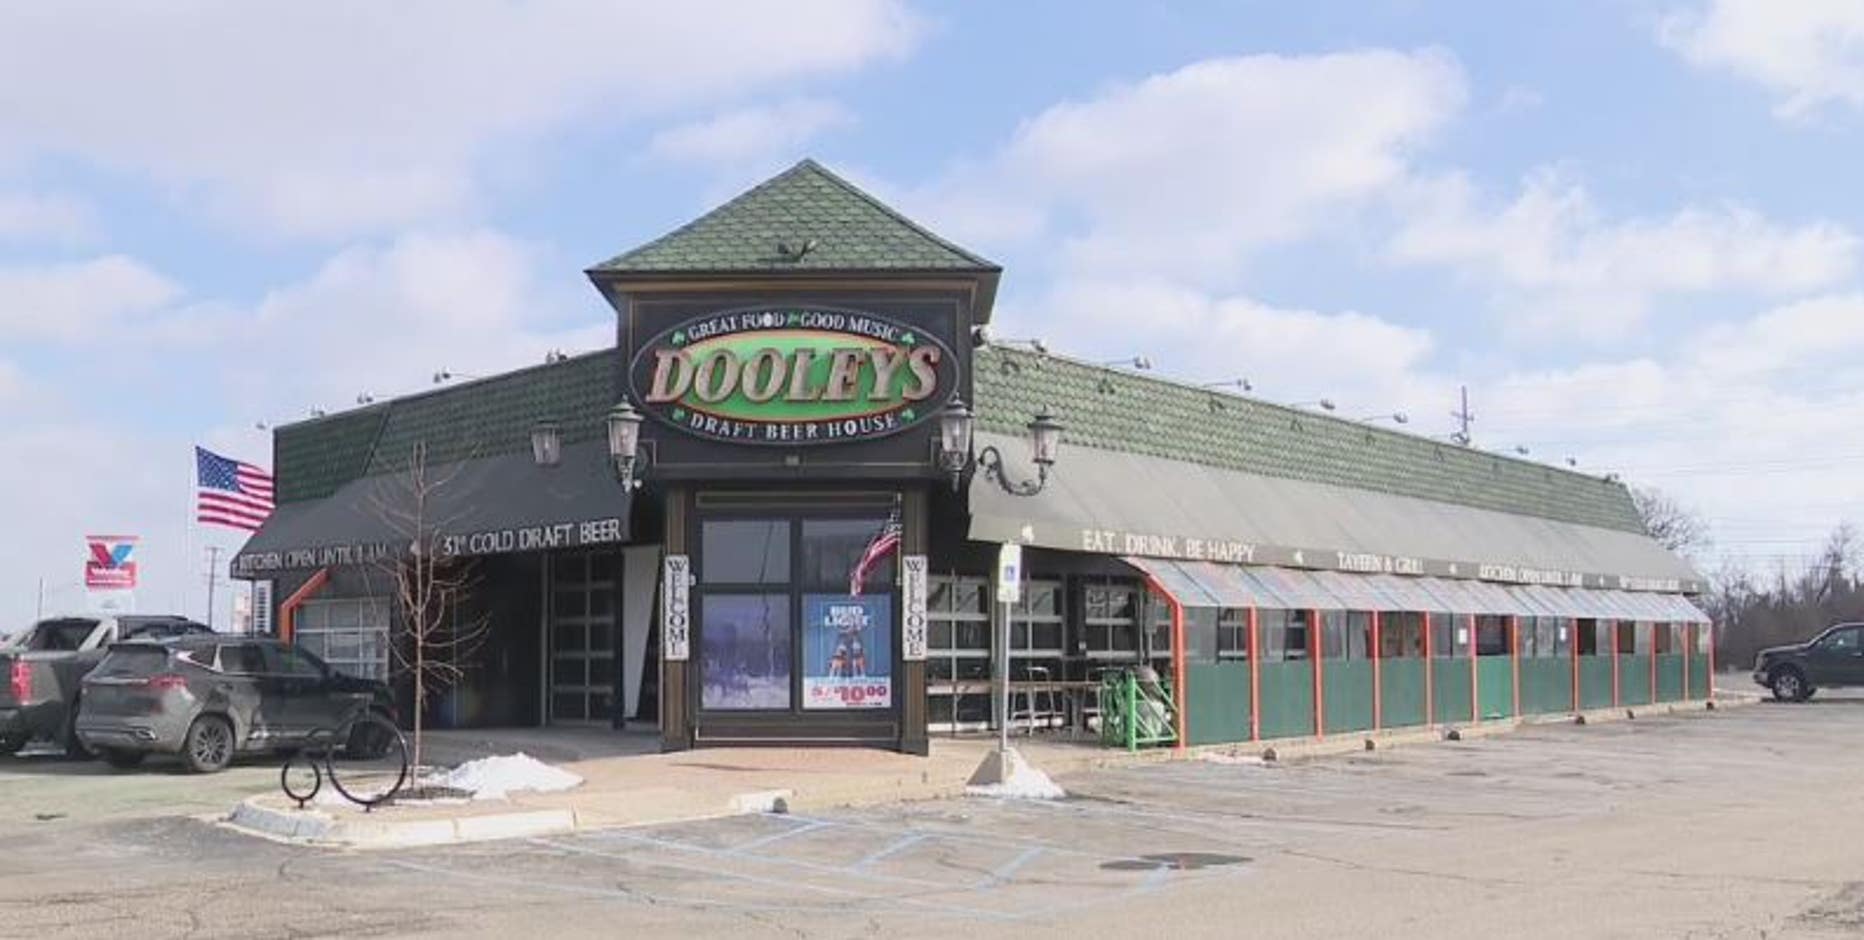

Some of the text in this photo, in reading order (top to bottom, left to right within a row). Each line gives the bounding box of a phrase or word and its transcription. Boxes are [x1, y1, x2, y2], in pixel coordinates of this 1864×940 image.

[688, 312, 899, 340] GREAT FOOD GOOD MUSIC
[646, 345, 940, 403] DOOLEYS
[690, 411, 898, 440] DRAFT BEER HOUSE
[470, 530, 513, 553] COLD
[519, 523, 574, 549] DRAFT
[580, 518, 621, 544] BEER
[1186, 538, 1204, 559] BE
[1208, 540, 1256, 563] HAPPY
[668, 560, 686, 656] WELCOME
[906, 560, 924, 657] WELCOME
